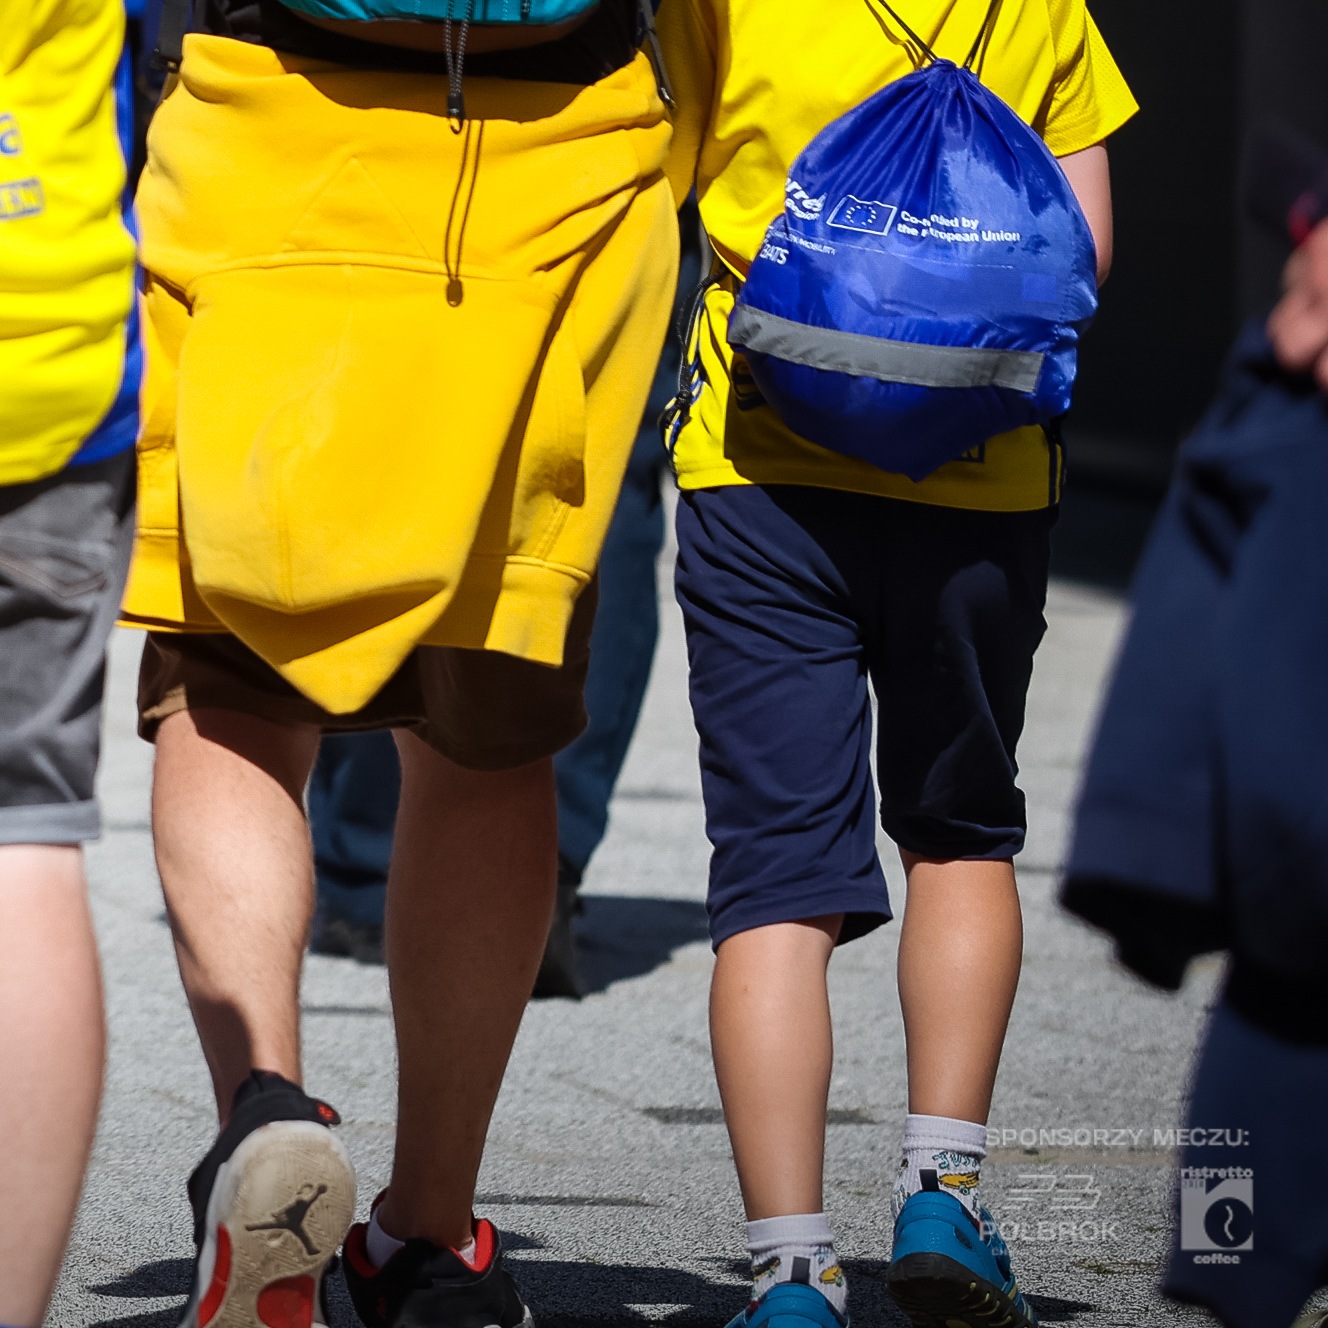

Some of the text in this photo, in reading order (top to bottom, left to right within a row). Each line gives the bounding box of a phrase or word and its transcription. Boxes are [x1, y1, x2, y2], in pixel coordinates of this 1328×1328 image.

[961, 217, 979, 230] by
[897, 223, 919, 236] the
[981, 230, 1021, 242] Union
